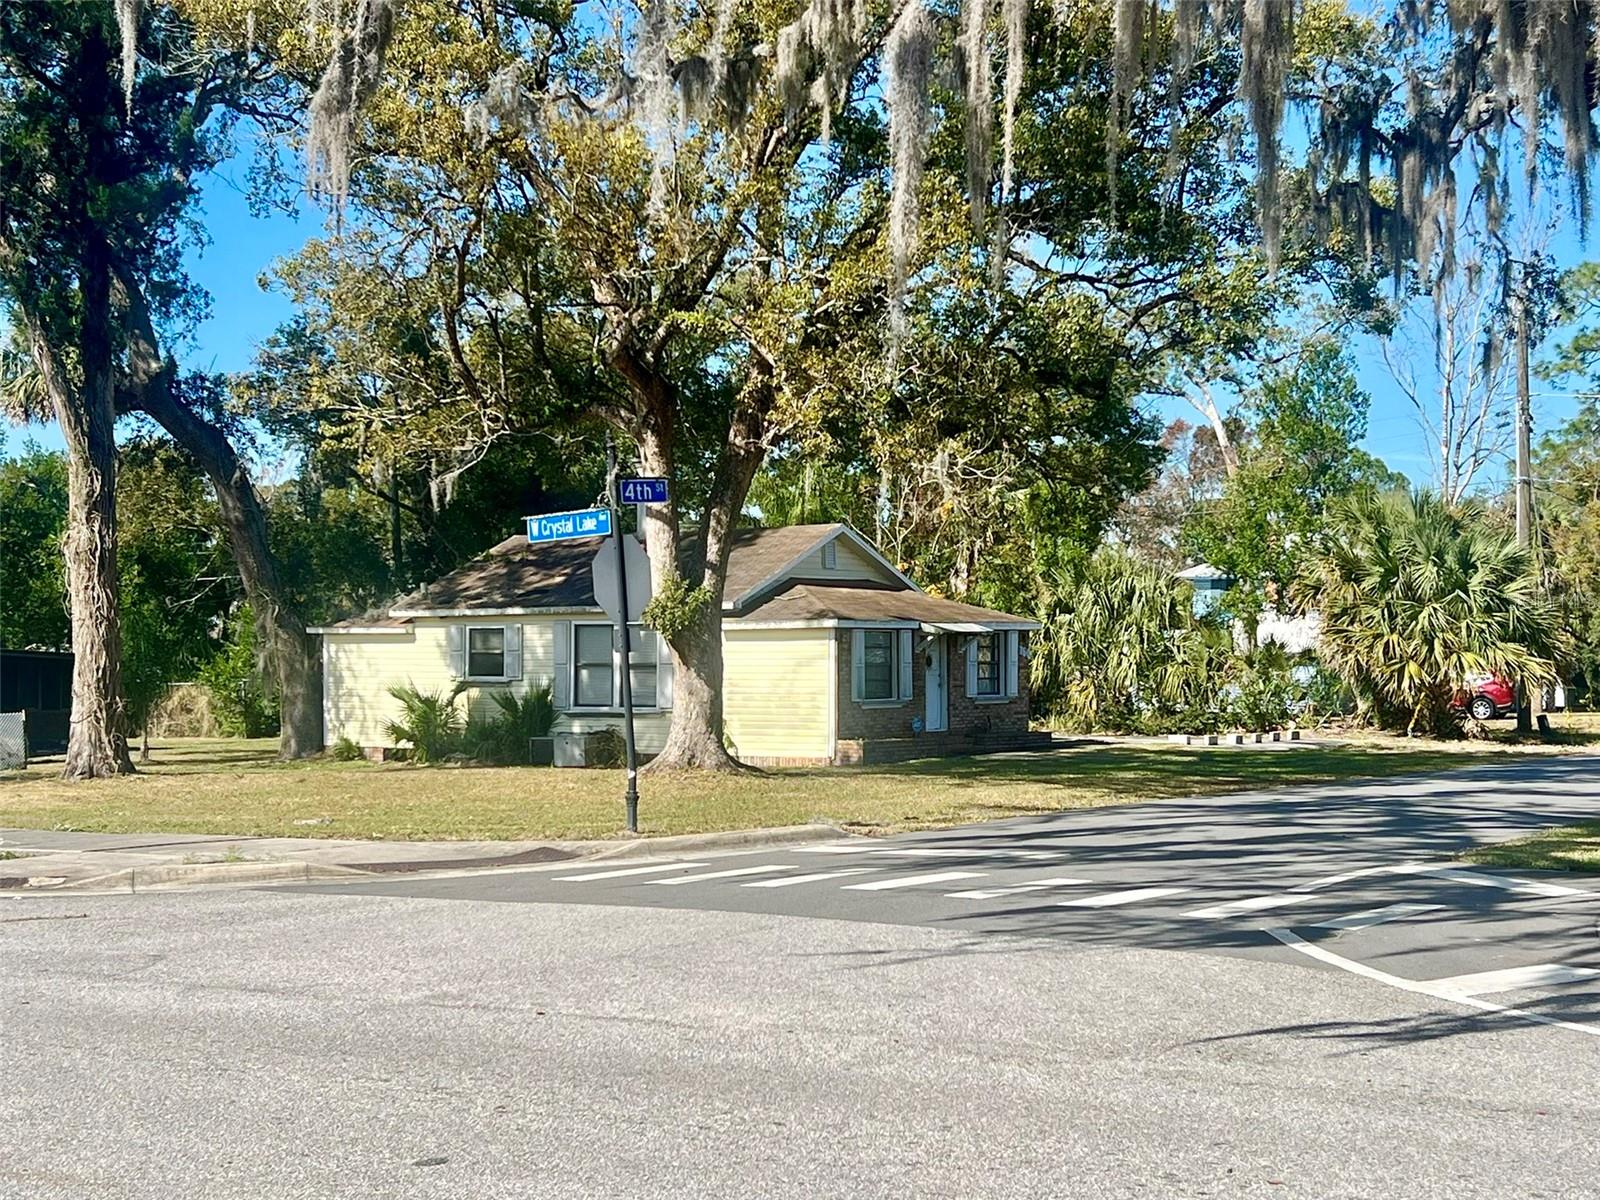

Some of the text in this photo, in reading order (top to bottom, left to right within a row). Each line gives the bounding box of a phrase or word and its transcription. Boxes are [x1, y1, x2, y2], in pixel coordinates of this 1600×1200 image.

[624, 483, 652, 500] 4th
[530, 518, 539, 537] W
[541, 516, 574, 540] Crystal
[576, 515, 598, 532] Lake
